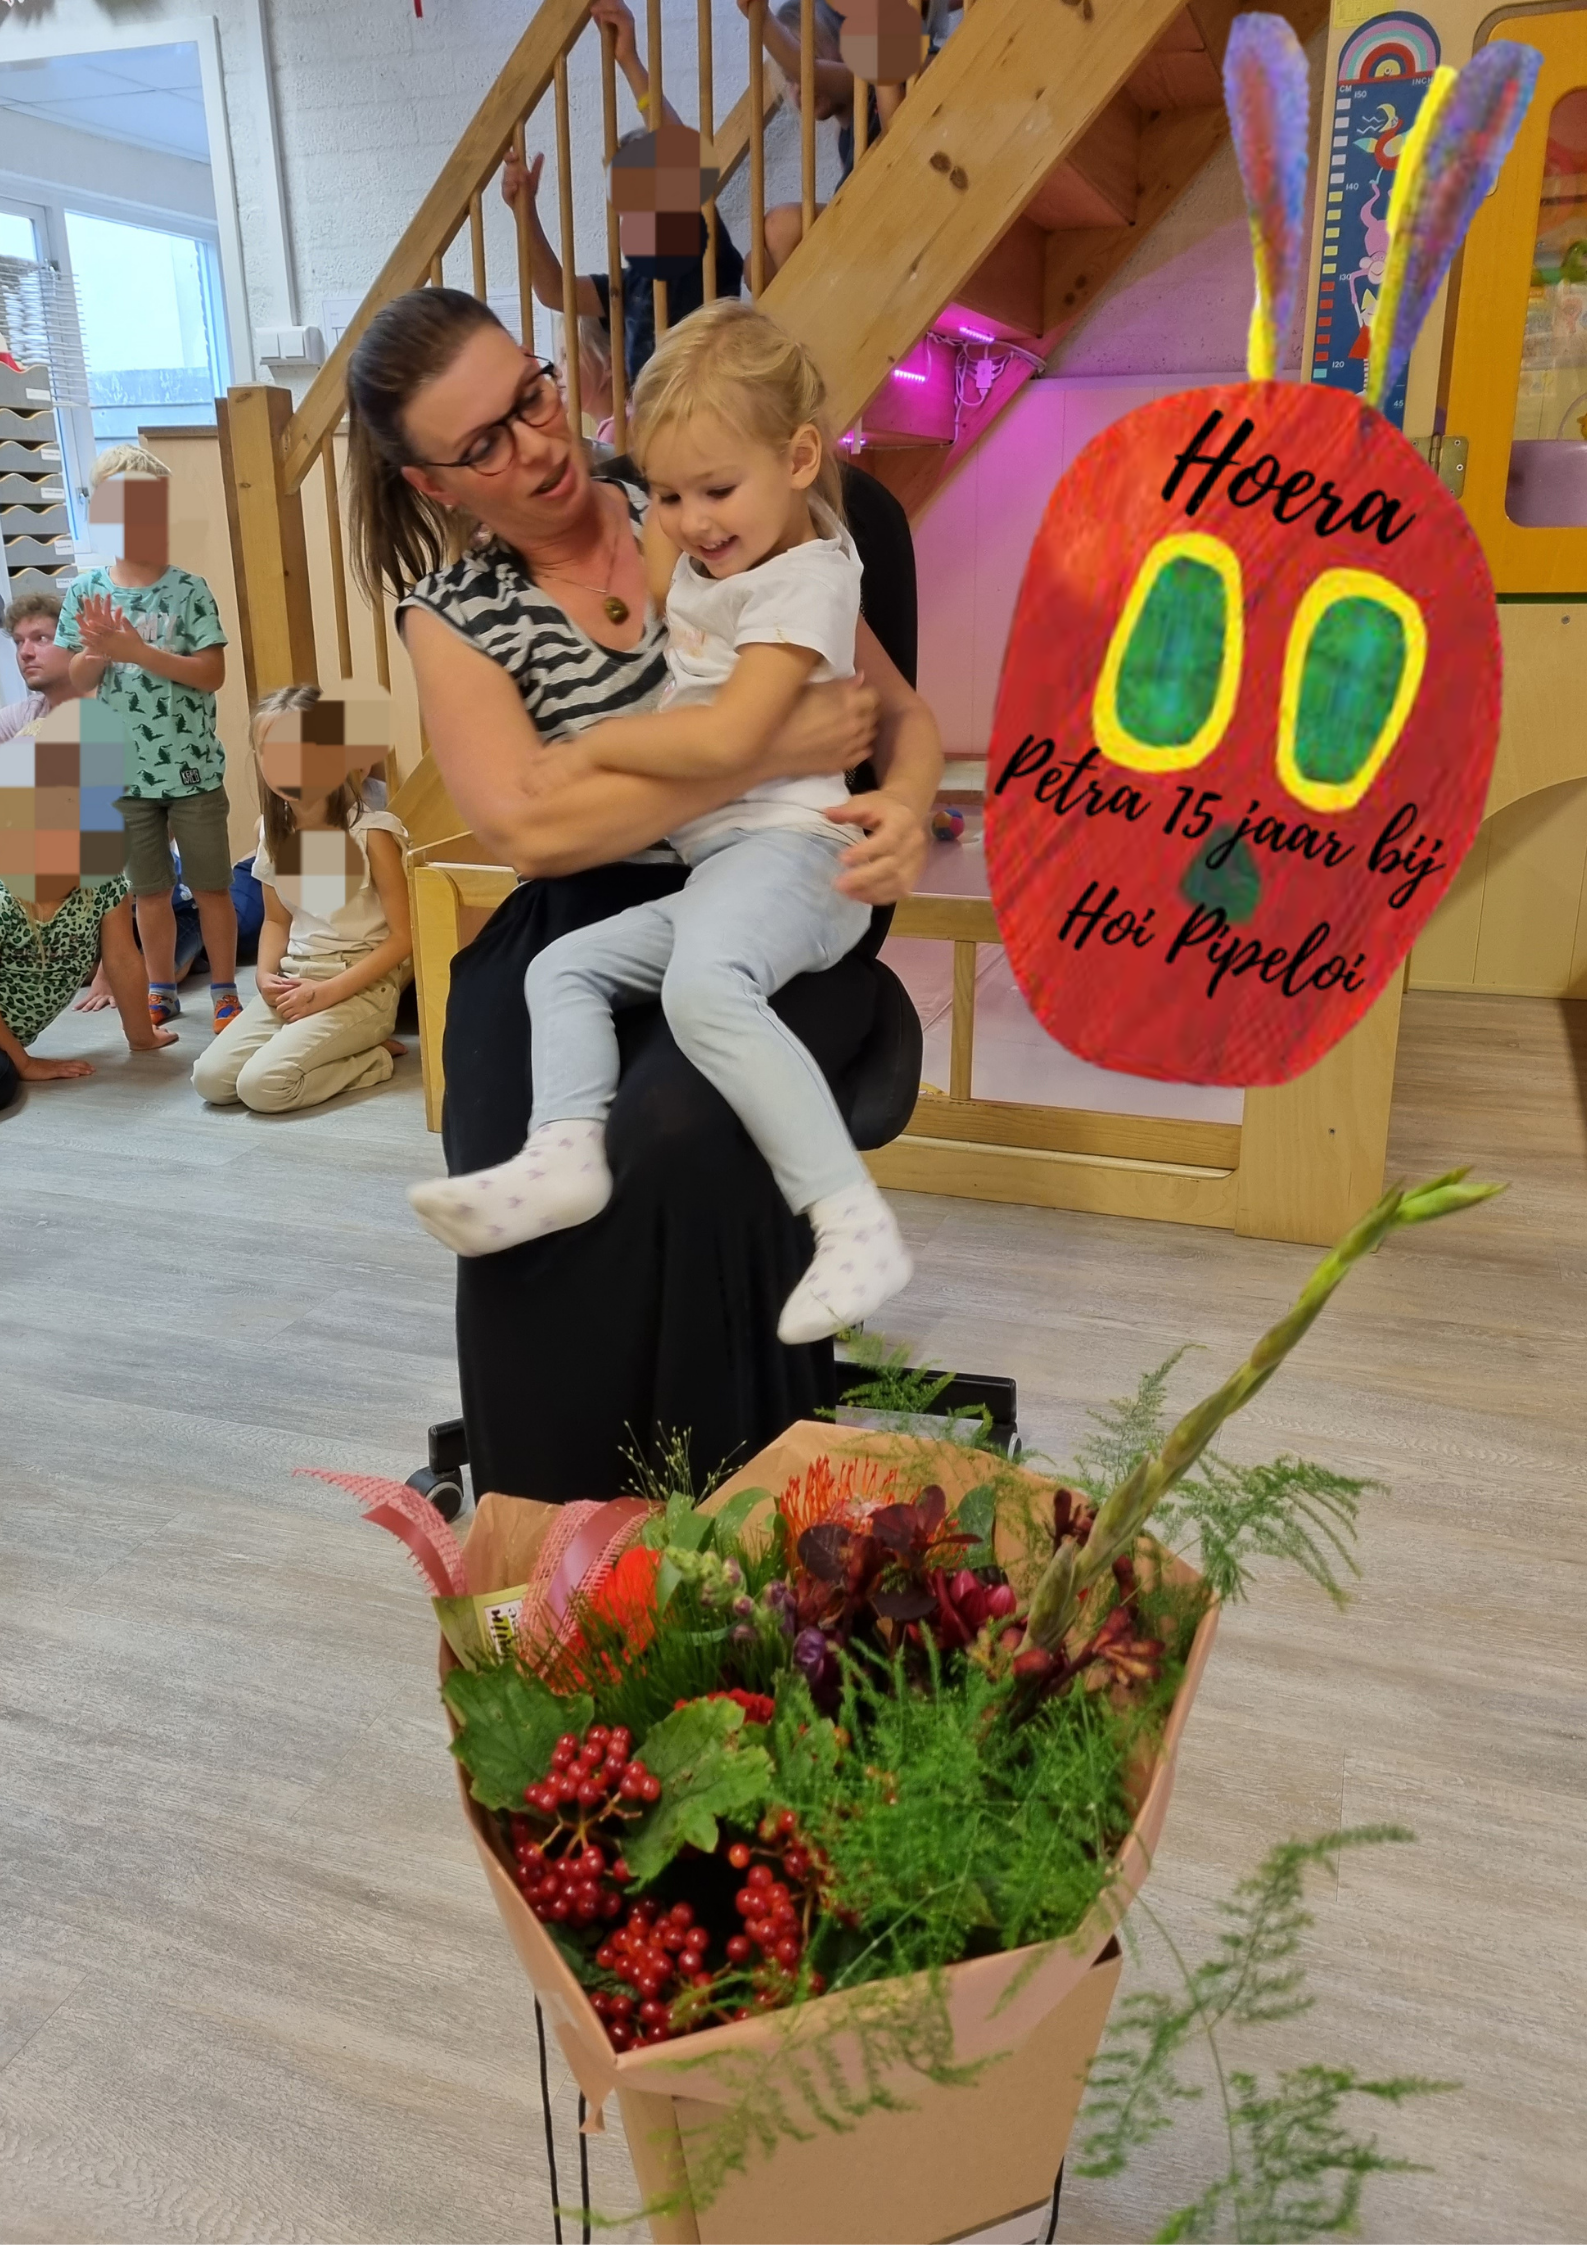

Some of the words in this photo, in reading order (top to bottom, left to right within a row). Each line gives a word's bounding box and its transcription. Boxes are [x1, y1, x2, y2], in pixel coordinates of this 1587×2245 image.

[1354, 90, 1367, 98] 150
[1345, 182, 1359, 190] 140
[1339, 273, 1352, 281] 130
[1332, 360, 1345, 368] 120
[1393, 399, 1404, 408] 45
